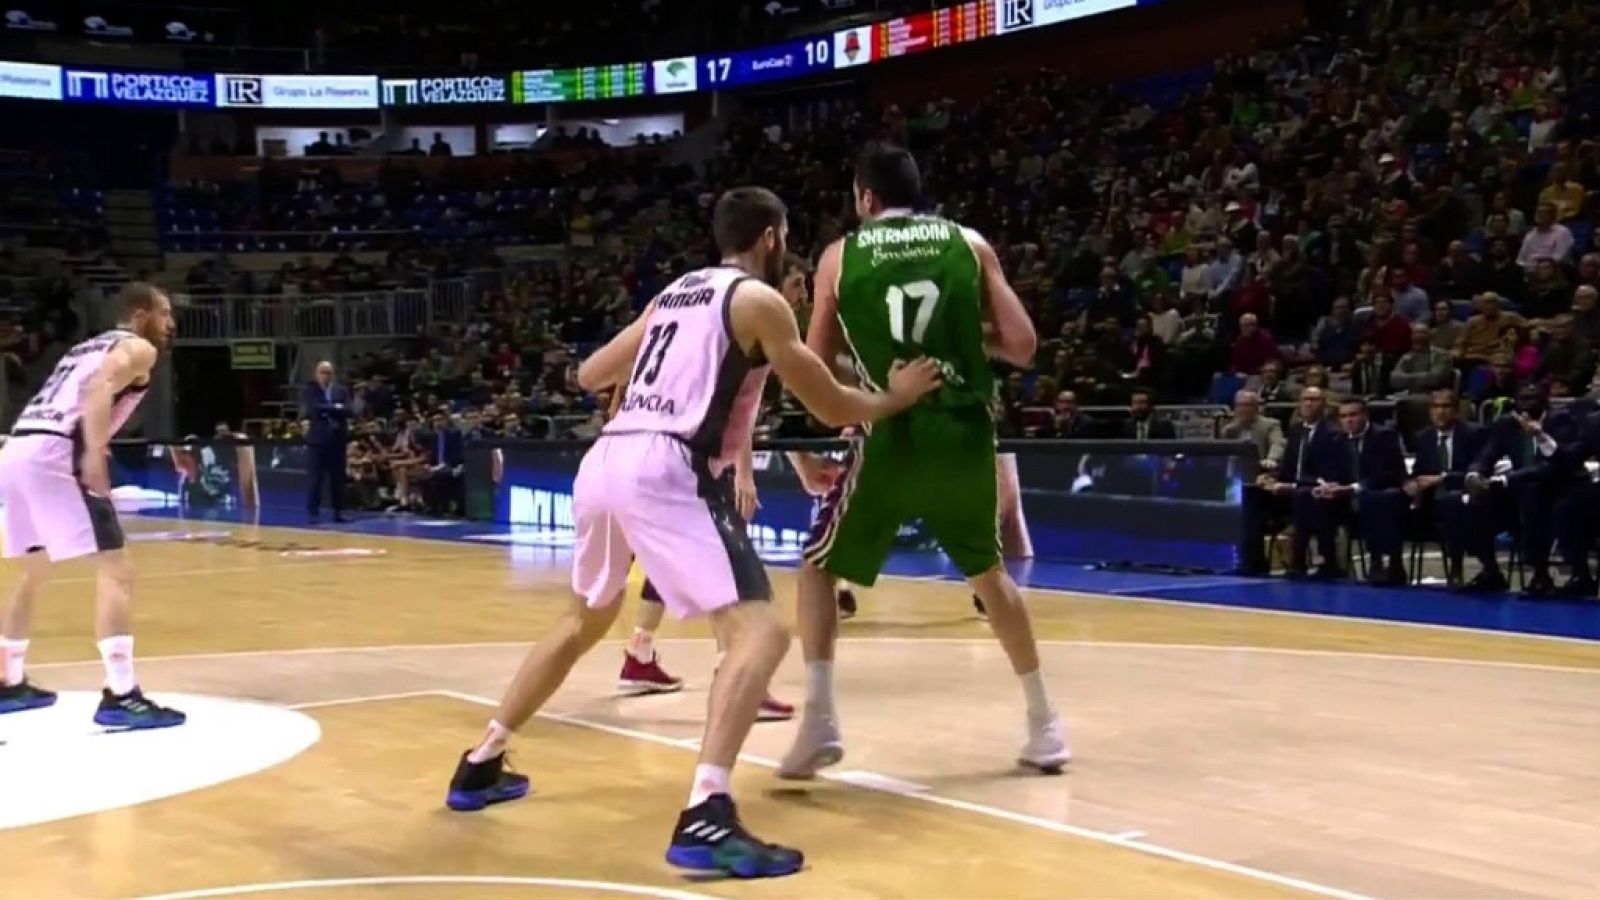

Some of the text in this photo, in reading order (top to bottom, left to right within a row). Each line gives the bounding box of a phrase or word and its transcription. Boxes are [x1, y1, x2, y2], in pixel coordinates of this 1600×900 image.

[707, 58, 731, 82] 17
[804, 40, 828, 65] 10
[112, 74, 194, 89] PORTICO
[421, 77, 492, 90] PORTICO
[113, 86, 208, 102] VELAZQUEZ
[273, 86, 369, 98] Grupo La Reserva
[422, 88, 505, 103] VELAZQUEZ
[857, 224, 951, 248] SHERMADINI
[886, 280, 940, 343] 17
[633, 320, 679, 387] 13
